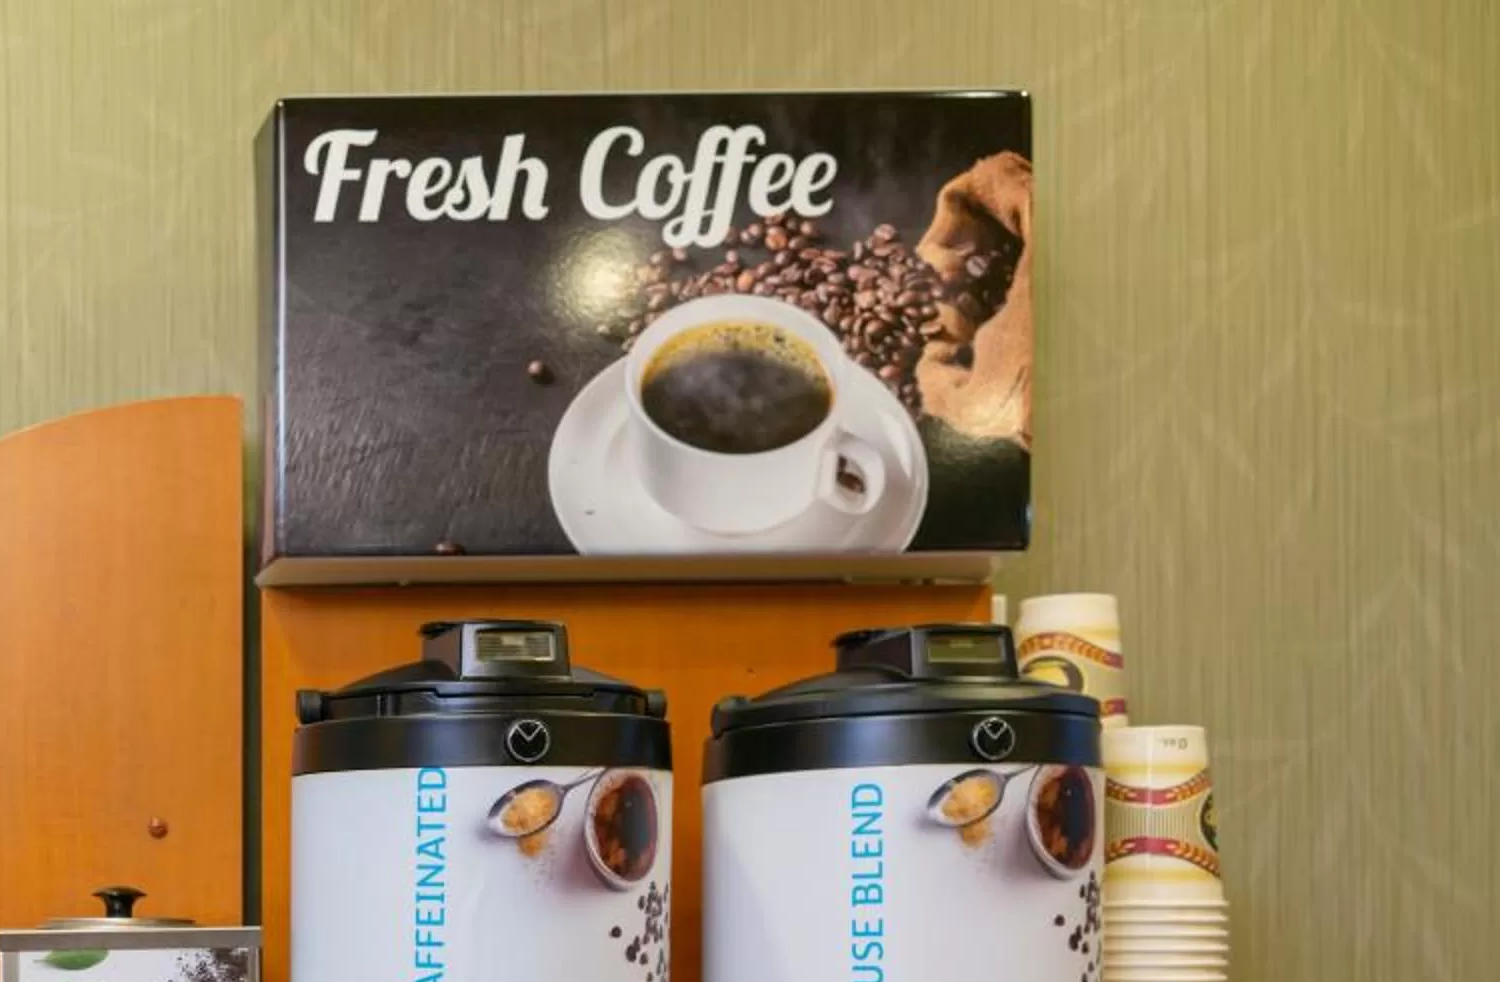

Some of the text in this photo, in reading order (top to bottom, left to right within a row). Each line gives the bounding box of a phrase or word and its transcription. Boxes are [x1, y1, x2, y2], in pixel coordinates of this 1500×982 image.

[303, 124, 837, 248] Fresh Coffee
[852, 783, 885, 907] BLEND
